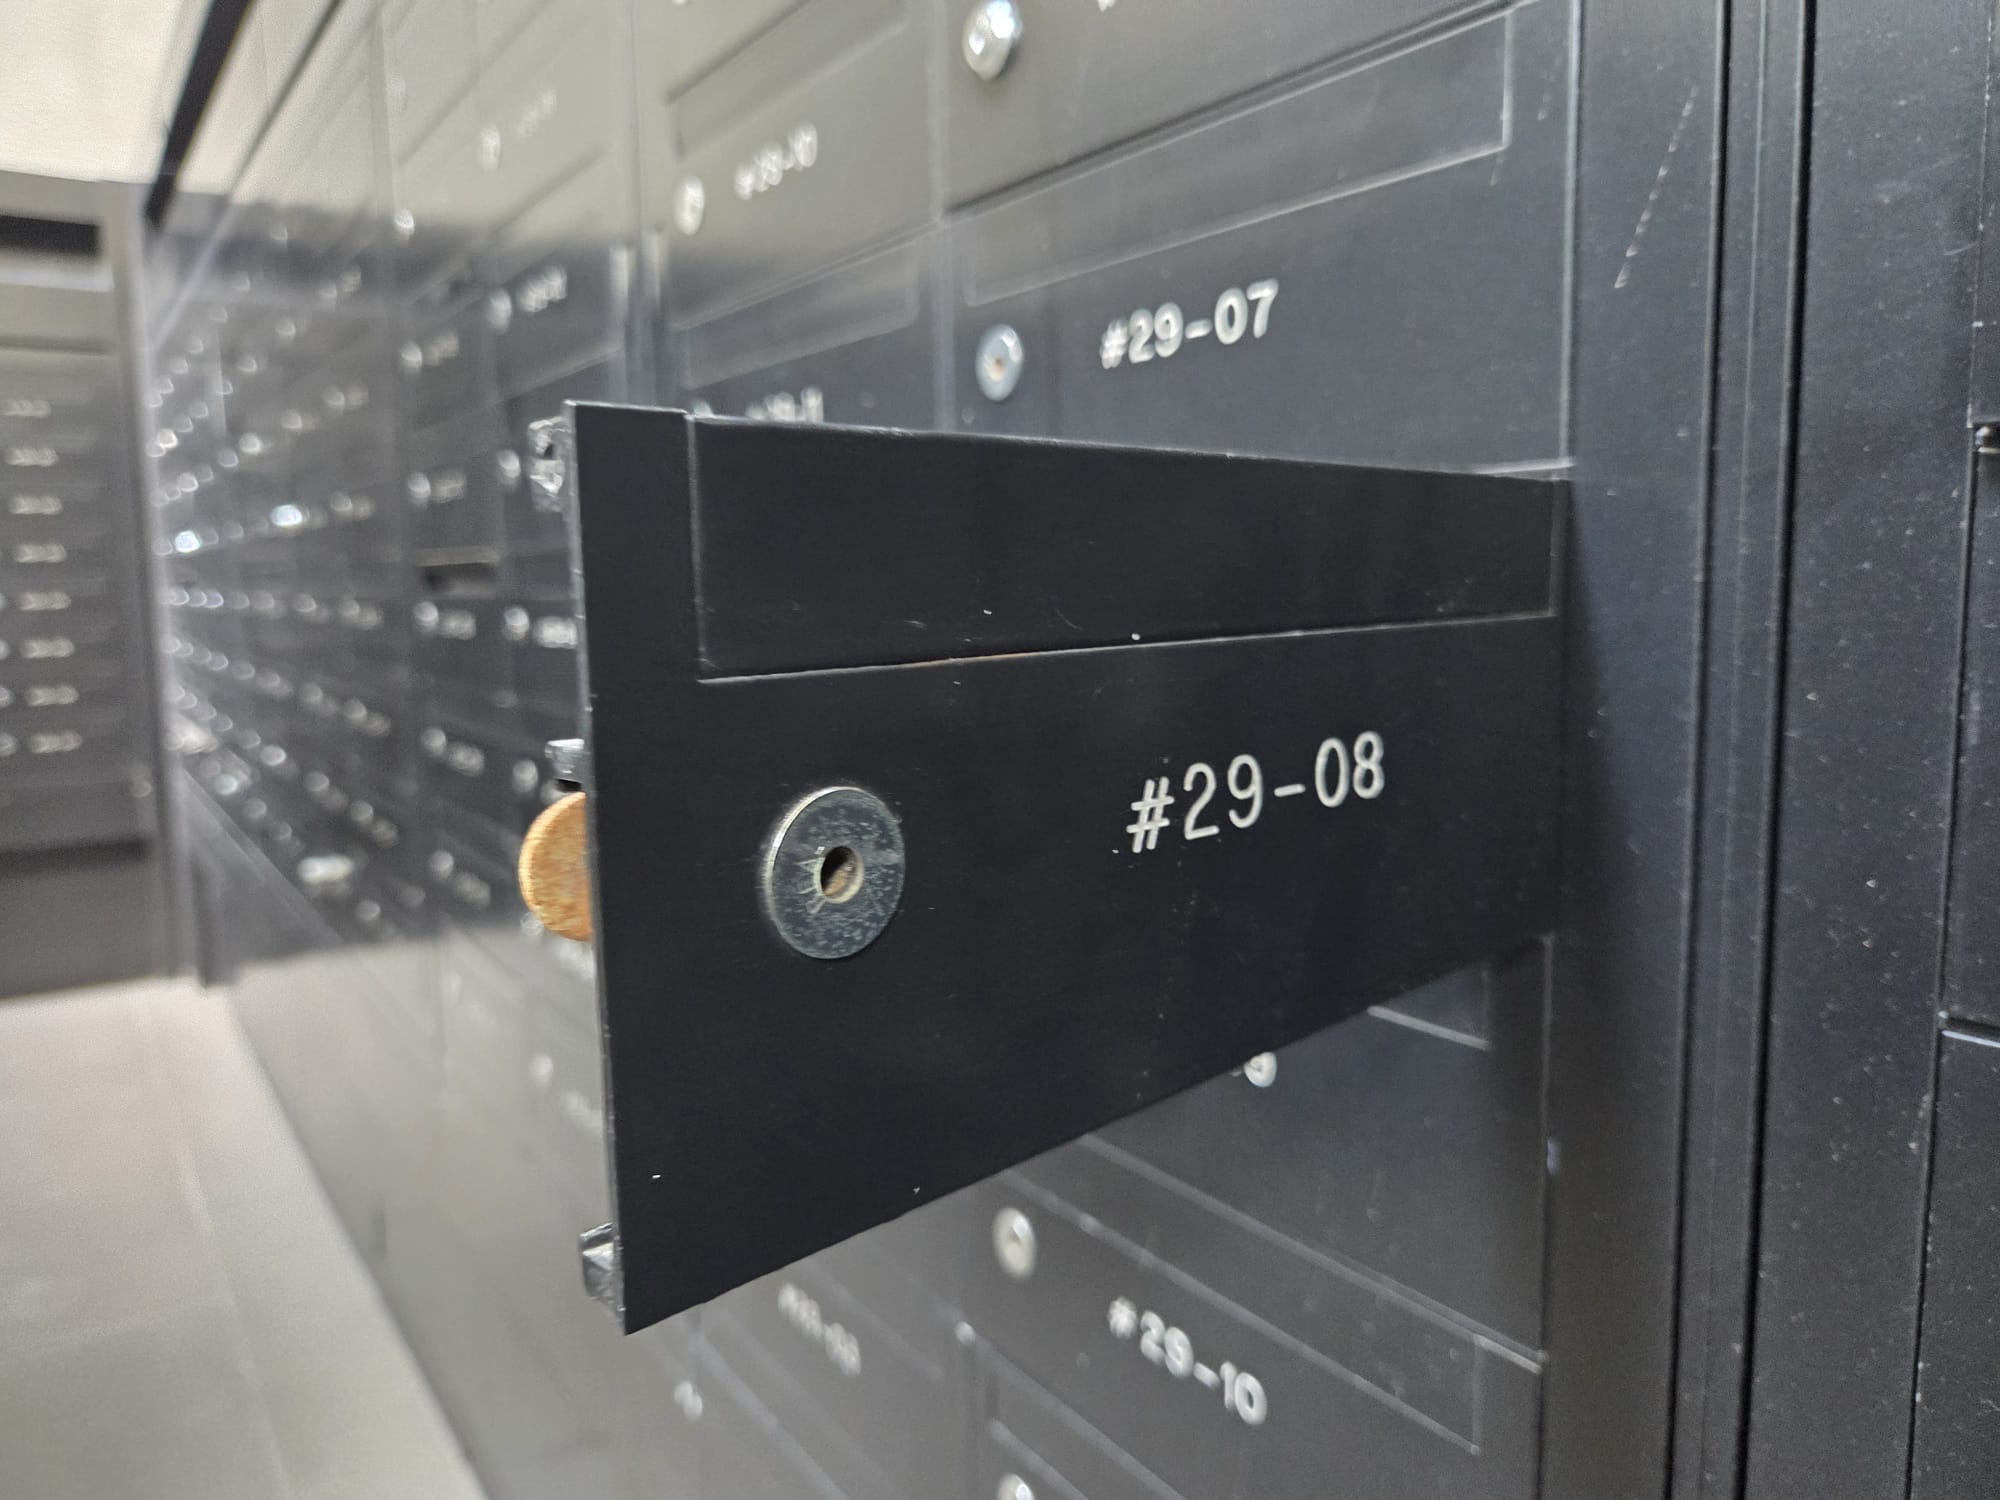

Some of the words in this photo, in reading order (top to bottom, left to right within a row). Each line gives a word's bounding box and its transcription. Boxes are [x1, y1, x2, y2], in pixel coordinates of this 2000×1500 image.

[1100, 278, 1279, 369] #29-07
[1126, 731, 1385, 853] #29-08
[1107, 1296, 1267, 1425] #29-10
